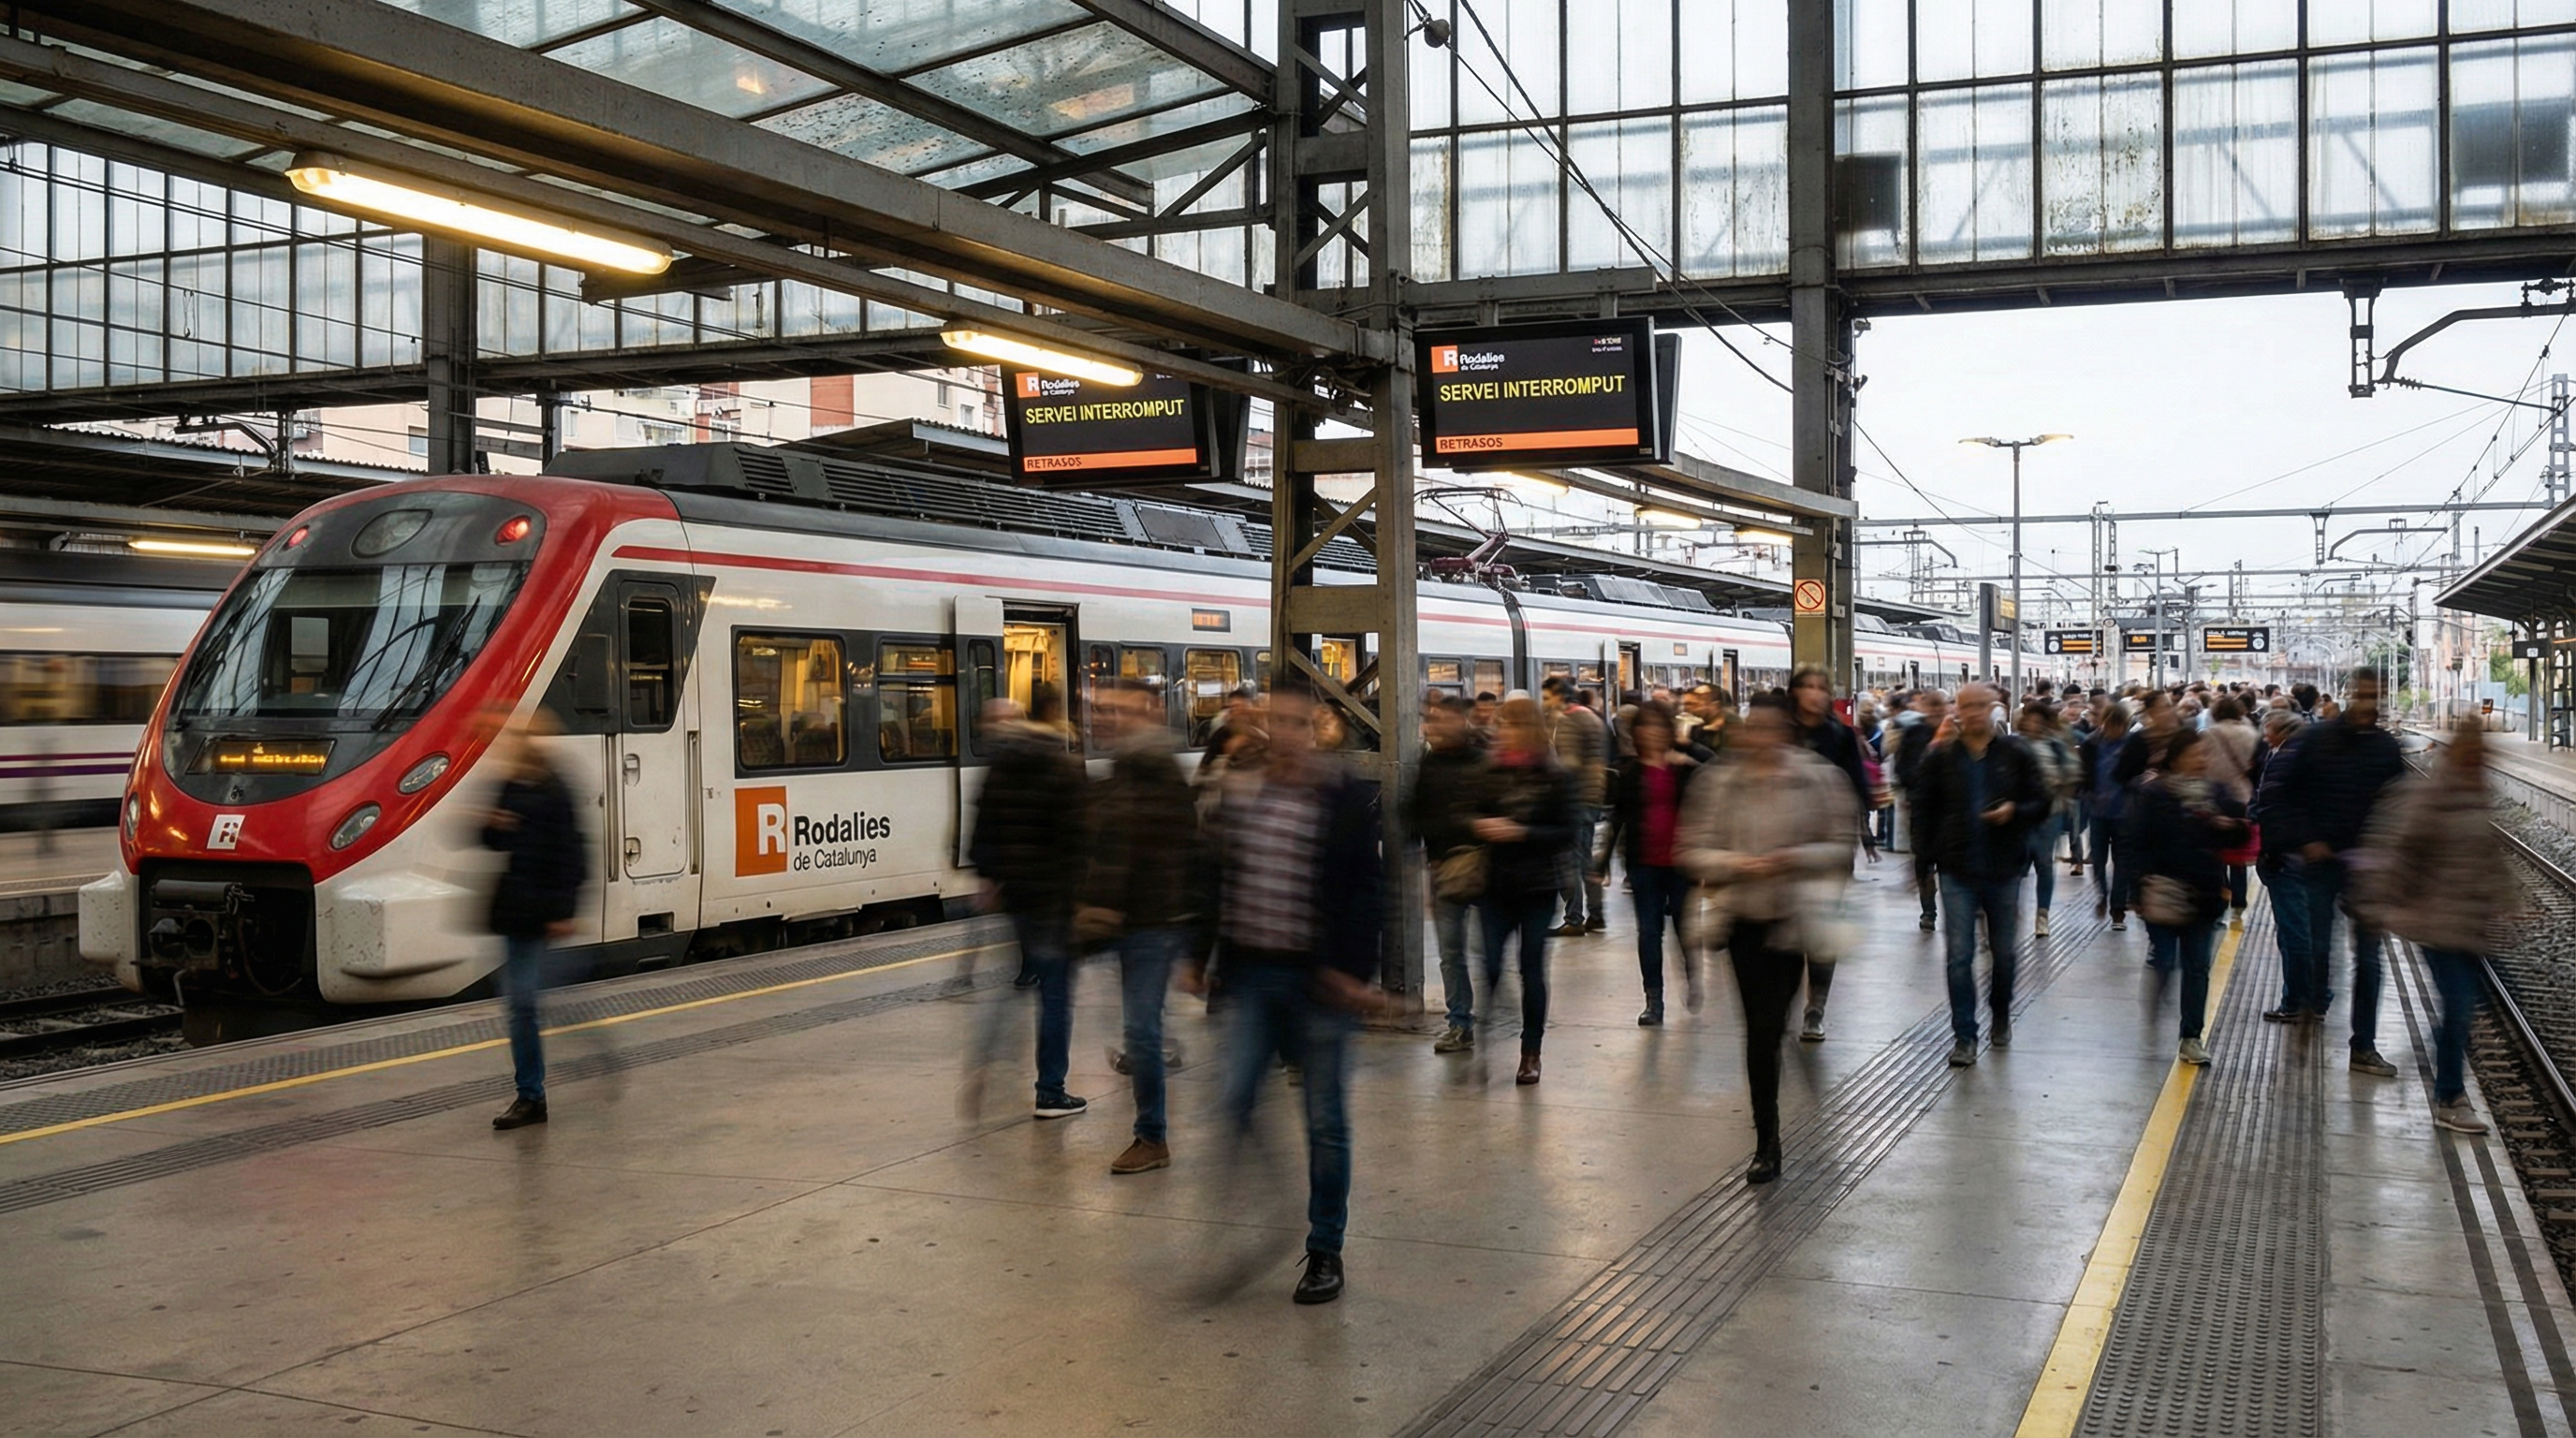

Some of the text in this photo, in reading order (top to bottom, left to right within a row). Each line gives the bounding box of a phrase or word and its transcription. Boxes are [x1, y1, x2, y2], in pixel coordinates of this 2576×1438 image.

[1443, 350, 1458, 366] R
[1026, 376, 1040, 391] R
[1440, 375, 1625, 402] SERVEI INTERROMPUT
[1026, 399, 1184, 424] SERVEI INTERROMPUT
[1027, 457, 1082, 469] RETRASOS
[758, 802, 890, 855] R Rodalies
[793, 846, 877, 871] de Catalunya
